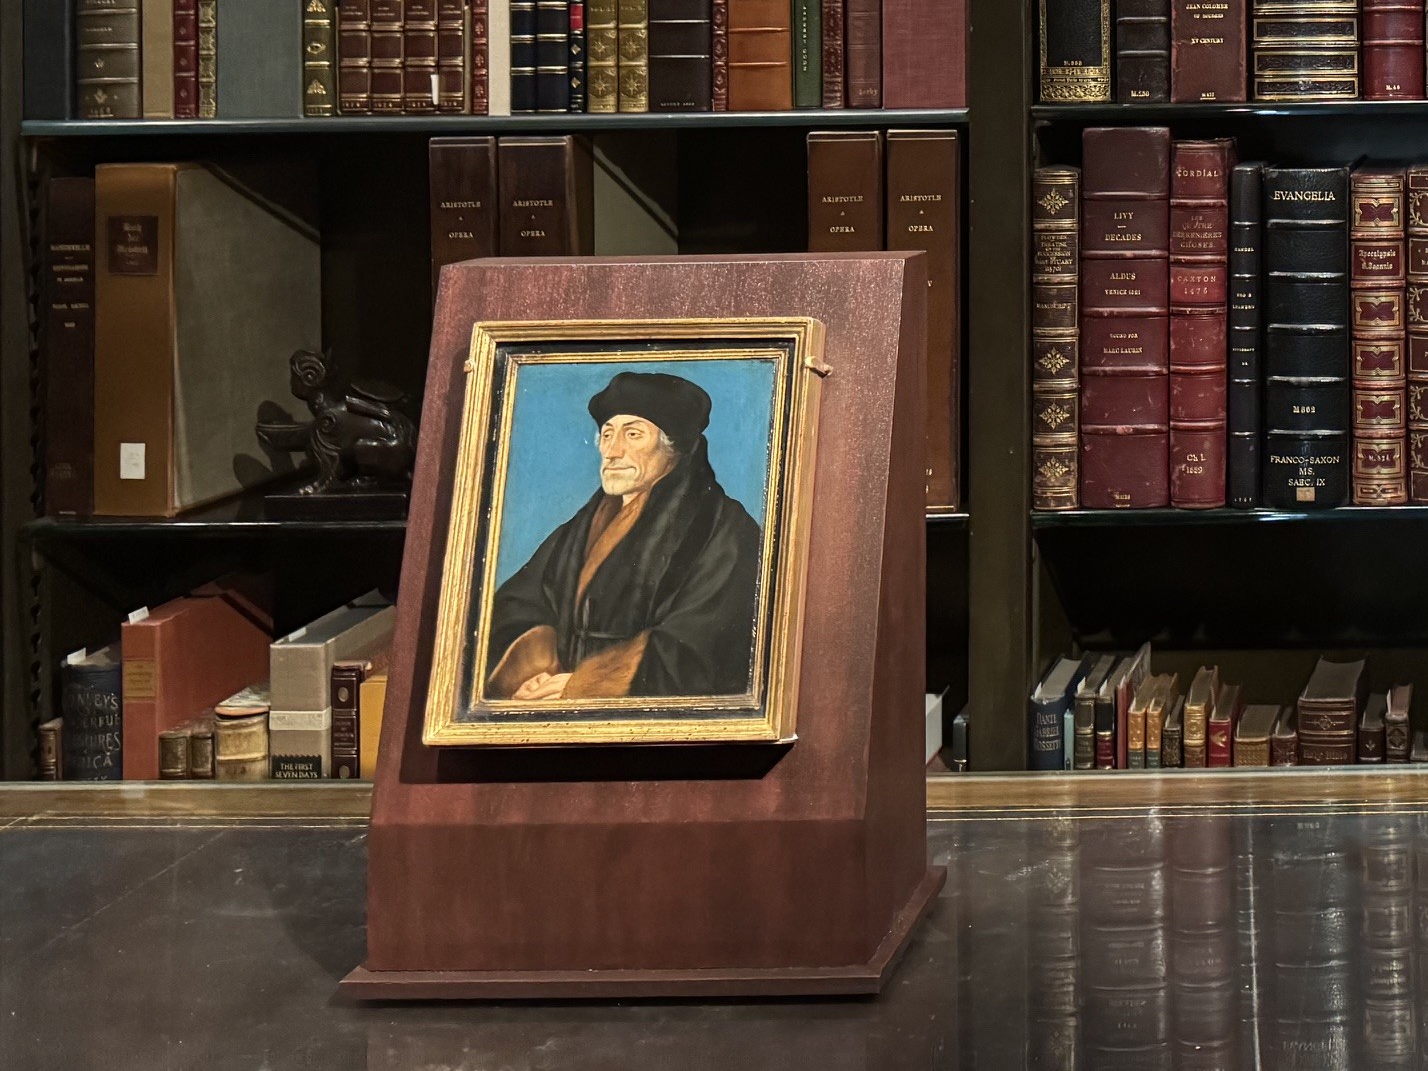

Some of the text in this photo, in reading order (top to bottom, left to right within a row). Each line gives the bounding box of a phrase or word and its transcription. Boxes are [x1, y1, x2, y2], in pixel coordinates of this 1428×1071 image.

[1176, 169, 1219, 178] CORDIAL
[1273, 190, 1336, 202] EVANGELIA
[1113, 212, 1134, 220] LIVY
[1104, 233, 1142, 241] DECADES
[1110, 272, 1136, 280] ALDUS
[1270, 455, 1340, 464] FRANCO-SAXON
[1299, 467, 1315, 476] MS.
[1316, 478, 1326, 487] IX
[298, 771, 318, 779] DAYS
